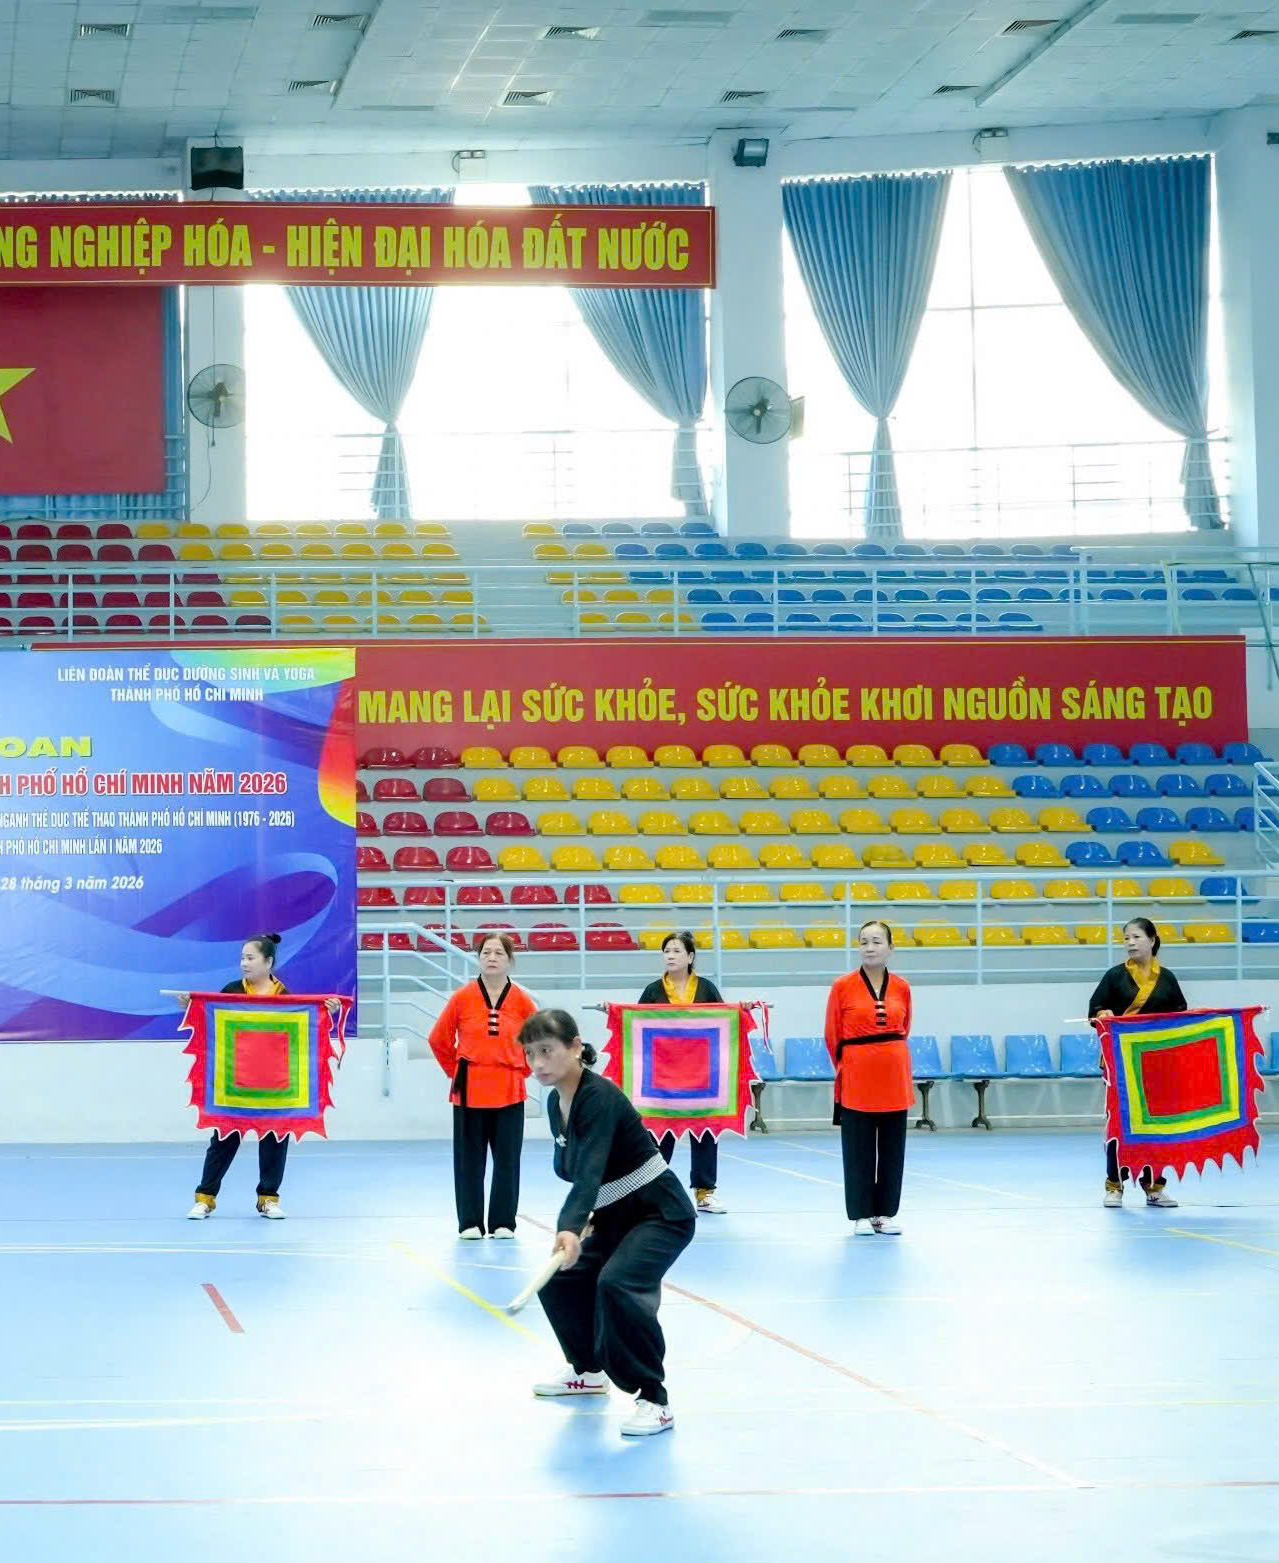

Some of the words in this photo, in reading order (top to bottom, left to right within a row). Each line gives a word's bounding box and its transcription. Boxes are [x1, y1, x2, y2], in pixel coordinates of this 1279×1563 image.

[50, 217, 169, 275] NGHIỆP
[183, 216, 252, 267] HÓA
[263, 244, 275, 255] -
[287, 217, 362, 275] HIỆN
[374, 226, 430, 275] ĐẠI
[444, 216, 511, 268] HÓA
[523, 213, 586, 269] ĐẤT
[597, 218, 689, 270] NƯỚC
[58, 666, 85, 682] LIÊN
[89, 665, 123, 681] ĐOÀN
[127, 662, 151, 681] THỂ
[154, 668, 179, 683] DỤC
[183, 665, 225, 681] DƯỠNG
[230, 667, 259, 680] SINH
[263, 665, 279, 680] VÀ
[283, 668, 314, 680] YOGA
[111, 686, 151, 701] THÀNH
[156, 685, 180, 701] PHỐ
[184, 686, 201, 701] HỒ
[205, 686, 225, 701] CHÍ
[230, 688, 263, 701] MINH
[358, 690, 452, 724] MANG
[463, 689, 510, 730] LẠI
[522, 683, 585, 722] SỨC
[595, 677, 686, 726] KHỎE,
[698, 683, 758, 721] SỨC
[770, 678, 848, 720] KHỎE
[861, 685, 933, 720] KHƠI
[944, 676, 1051, 720] NGUỒN
[1062, 680, 1145, 719] SÁNG
[1155, 686, 1212, 727] TẠO
[18, 767, 57, 796] PHỐ
[61, 767, 89, 796] HỒ
[93, 769, 126, 795] CHÍ
[131, 773, 184, 795] MINH
[189, 768, 234, 794] NĂM
[240, 772, 287, 794] 2026
[0, 877, 17, 890] 28
[22, 875, 61, 894] tháng
[64, 876, 72, 889] 3
[77, 876, 107, 889] năm
[111, 876, 144, 889] 2026
